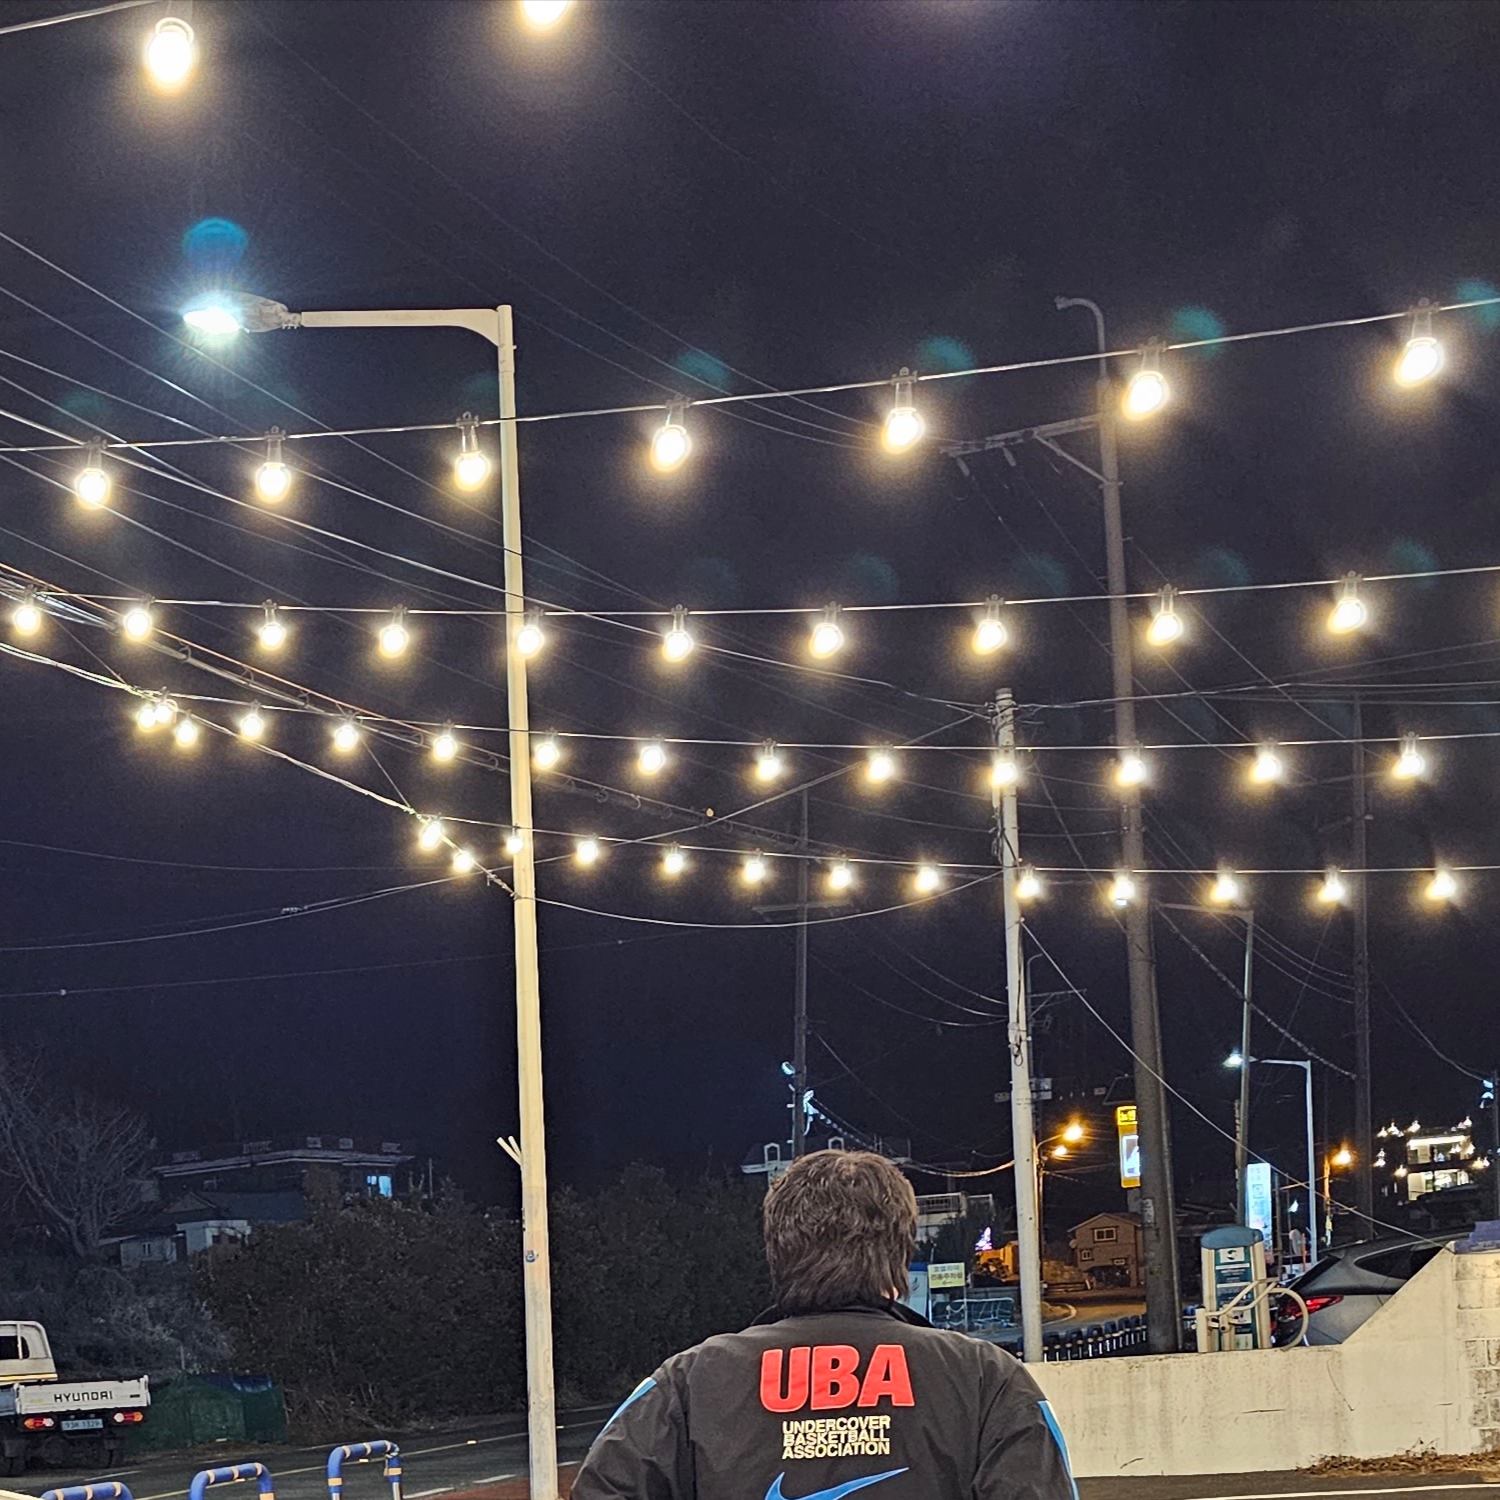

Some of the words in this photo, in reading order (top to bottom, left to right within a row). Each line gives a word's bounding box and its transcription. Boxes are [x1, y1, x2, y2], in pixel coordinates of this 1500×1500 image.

[760, 1345, 915, 1413] UBA
[54, 1390, 113, 1403] HYUNDAI
[782, 1415, 891, 1434] UNDERCOVER
[783, 1429, 890, 1447] BASKETBALL
[782, 1441, 890, 1460] ASSOCIATION
